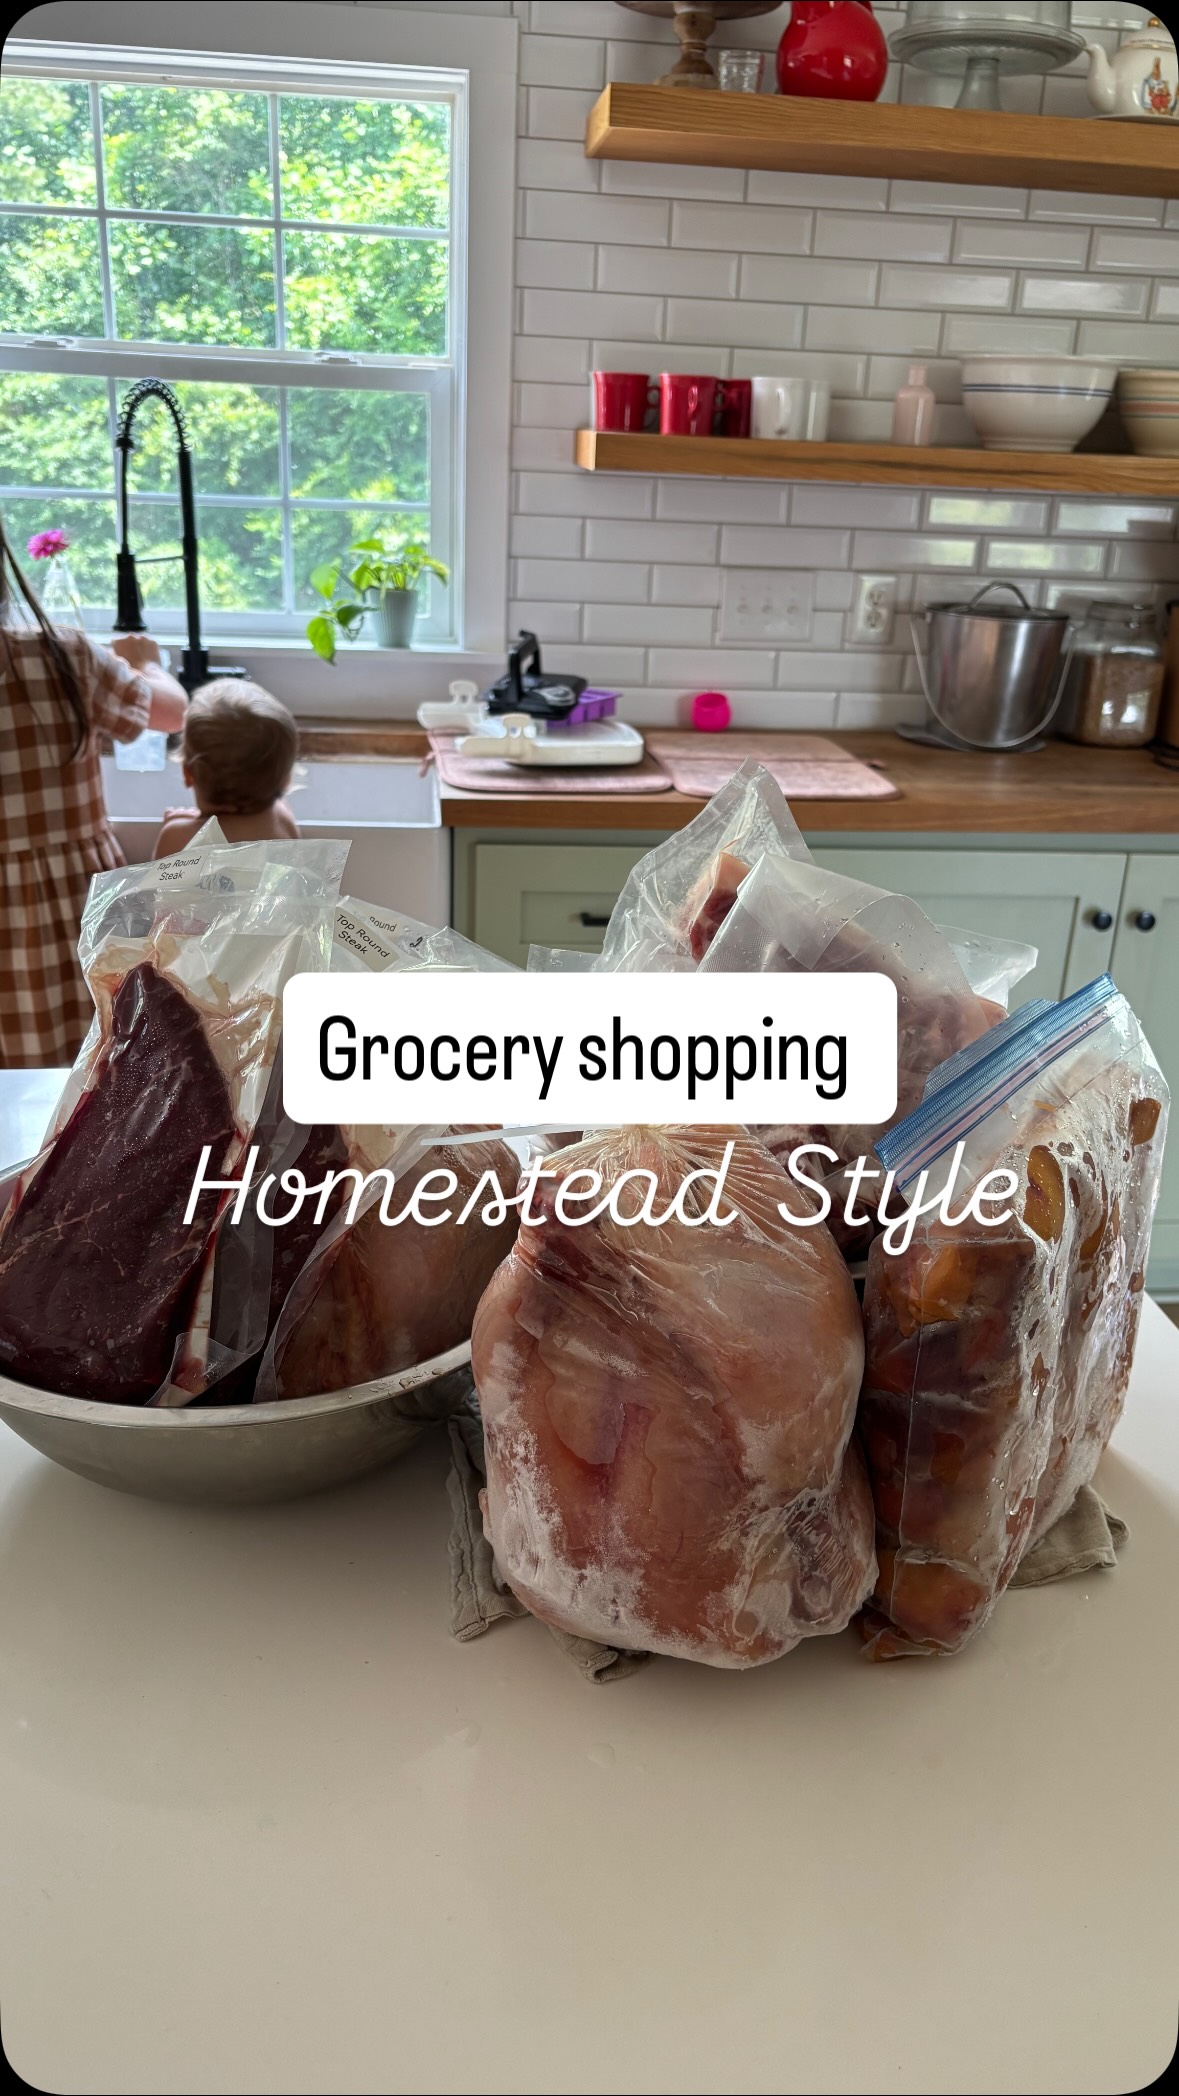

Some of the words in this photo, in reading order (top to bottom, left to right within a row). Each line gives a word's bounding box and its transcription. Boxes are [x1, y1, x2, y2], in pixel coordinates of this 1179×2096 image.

[157, 862, 172, 872] Top
[172, 856, 202, 868] Round
[159, 870, 185, 881] Steak
[336, 914, 355, 930] Top
[356, 928, 391, 958] Round
[338, 930, 369, 955] Steak
